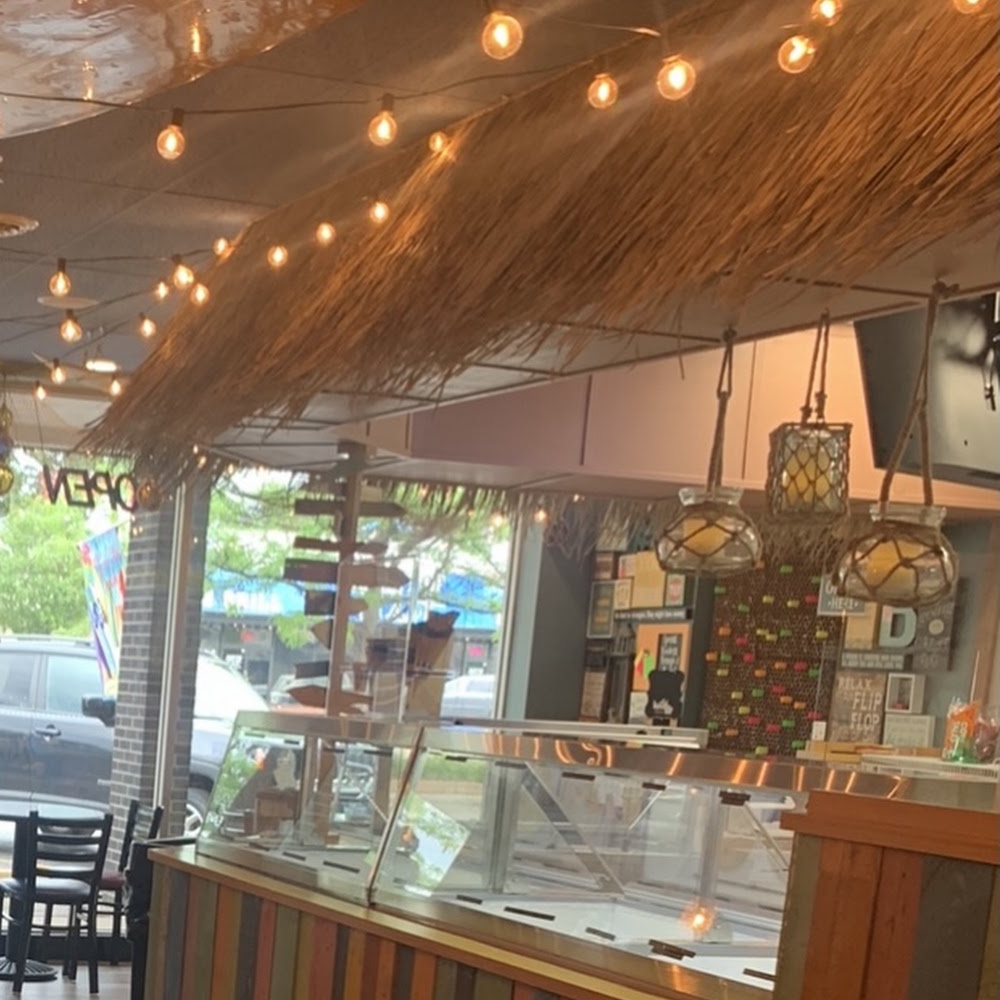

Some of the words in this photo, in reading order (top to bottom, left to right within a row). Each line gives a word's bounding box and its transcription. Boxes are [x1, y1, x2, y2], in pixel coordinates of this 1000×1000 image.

[879, 605, 918, 648] D
[838, 677, 873, 690] RELAX
[852, 692, 883, 712] FLIP
[849, 712, 880, 732] FLOP
